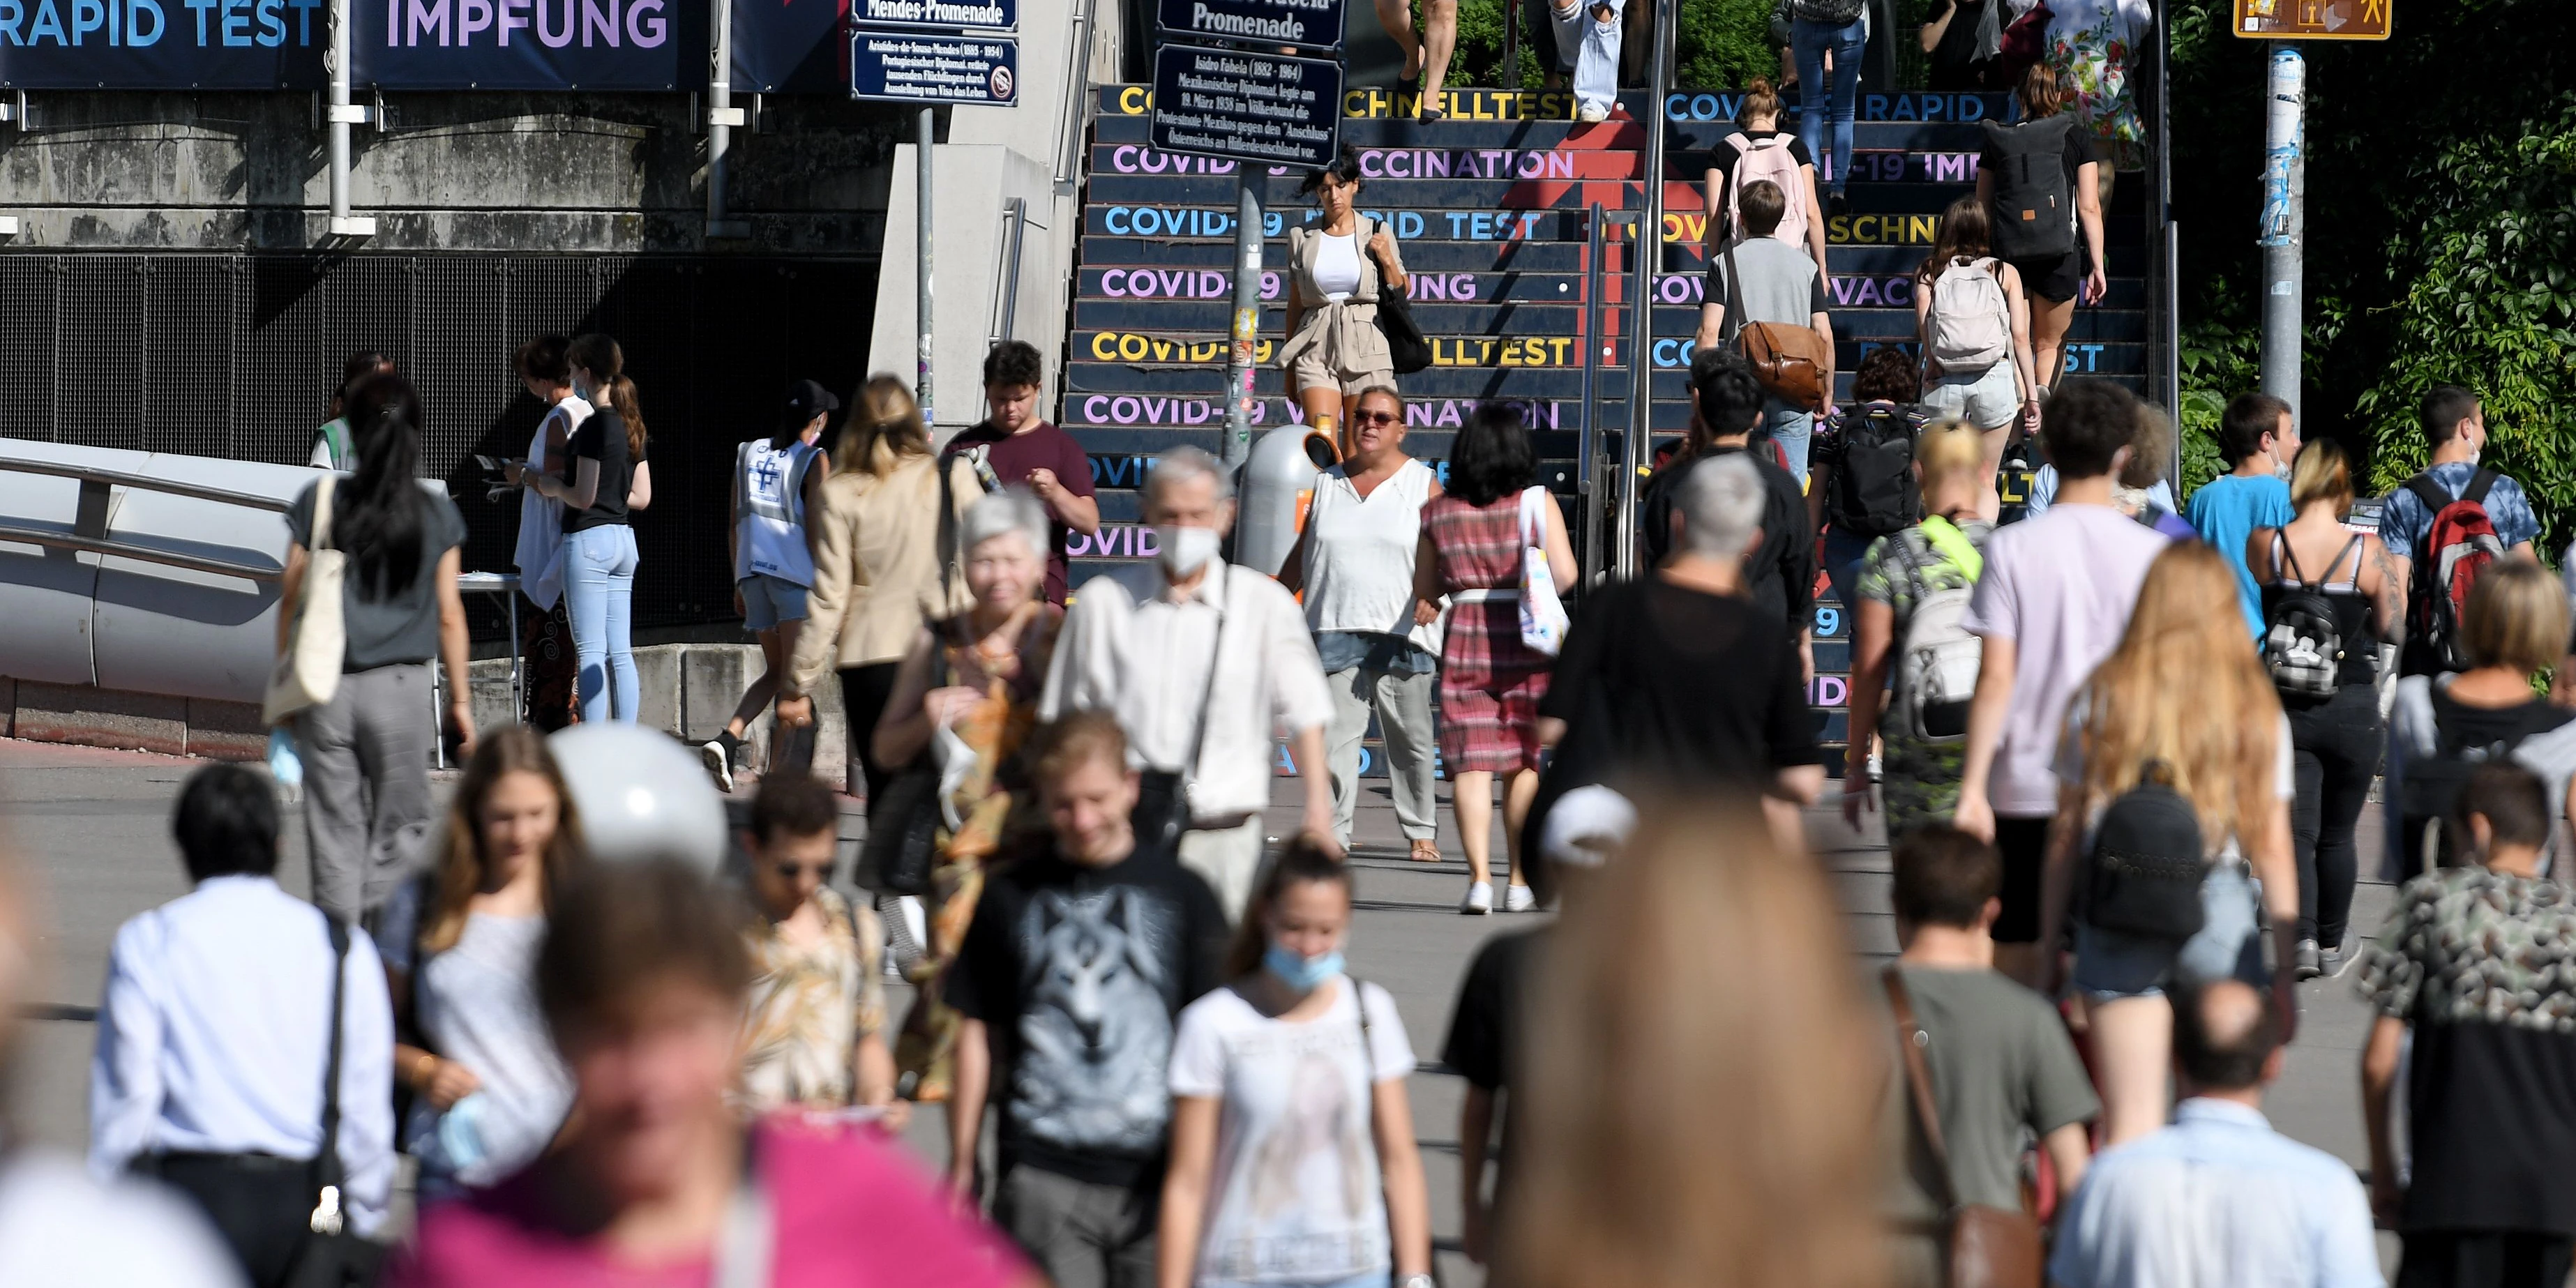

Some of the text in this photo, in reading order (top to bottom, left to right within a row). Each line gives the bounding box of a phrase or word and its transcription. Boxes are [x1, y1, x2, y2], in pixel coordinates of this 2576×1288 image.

[0, 0, 321, 47] RAPID TEST
[388, 0, 667, 47] IMPFUNG
[867, 0, 1003, 24] Mendes-Promenade
[1193, 2, 1304, 40] Promenade
[882, 54, 935, 69] Portugiesischer
[1195, 55, 1219, 71] Isidro
[1220, 57, 1247, 74] Fabela
[1279, 62, 1302, 83] 1964)
[884, 82, 988, 98] Ausstellung von Visa das Leben
[886, 68, 986, 84] tausenden Flüchtlingen durch
[1178, 73, 1238, 92] Mexikanischer
[1279, 84, 1300, 101] legte
[1301, 89, 1316, 101] am
[1181, 92, 1192, 107] 19.
[1193, 93, 1214, 109] März
[1235, 98, 1247, 112] im
[1248, 98, 1295, 119] Völkerbund
[1295, 105, 1309, 120] die
[1866, 94, 1984, 121] RAPID
[1156, 108, 1202, 127] Protestnote
[1203, 114, 1237, 130] Mexikos
[1237, 121, 1263, 136] gegen
[1264, 121, 1281, 136] den
[1168, 127, 1317, 160] Österreichs an Hitlerdeutschland vor.
[1359, 150, 1574, 178] CCINATION
[1106, 207, 1283, 236] COVID-9
[1445, 212, 1540, 239] TEST
[1101, 268, 1281, 298] COVID-9
[1092, 332, 1272, 361] COVID-9
[1084, 395, 1265, 424] COVID-9
